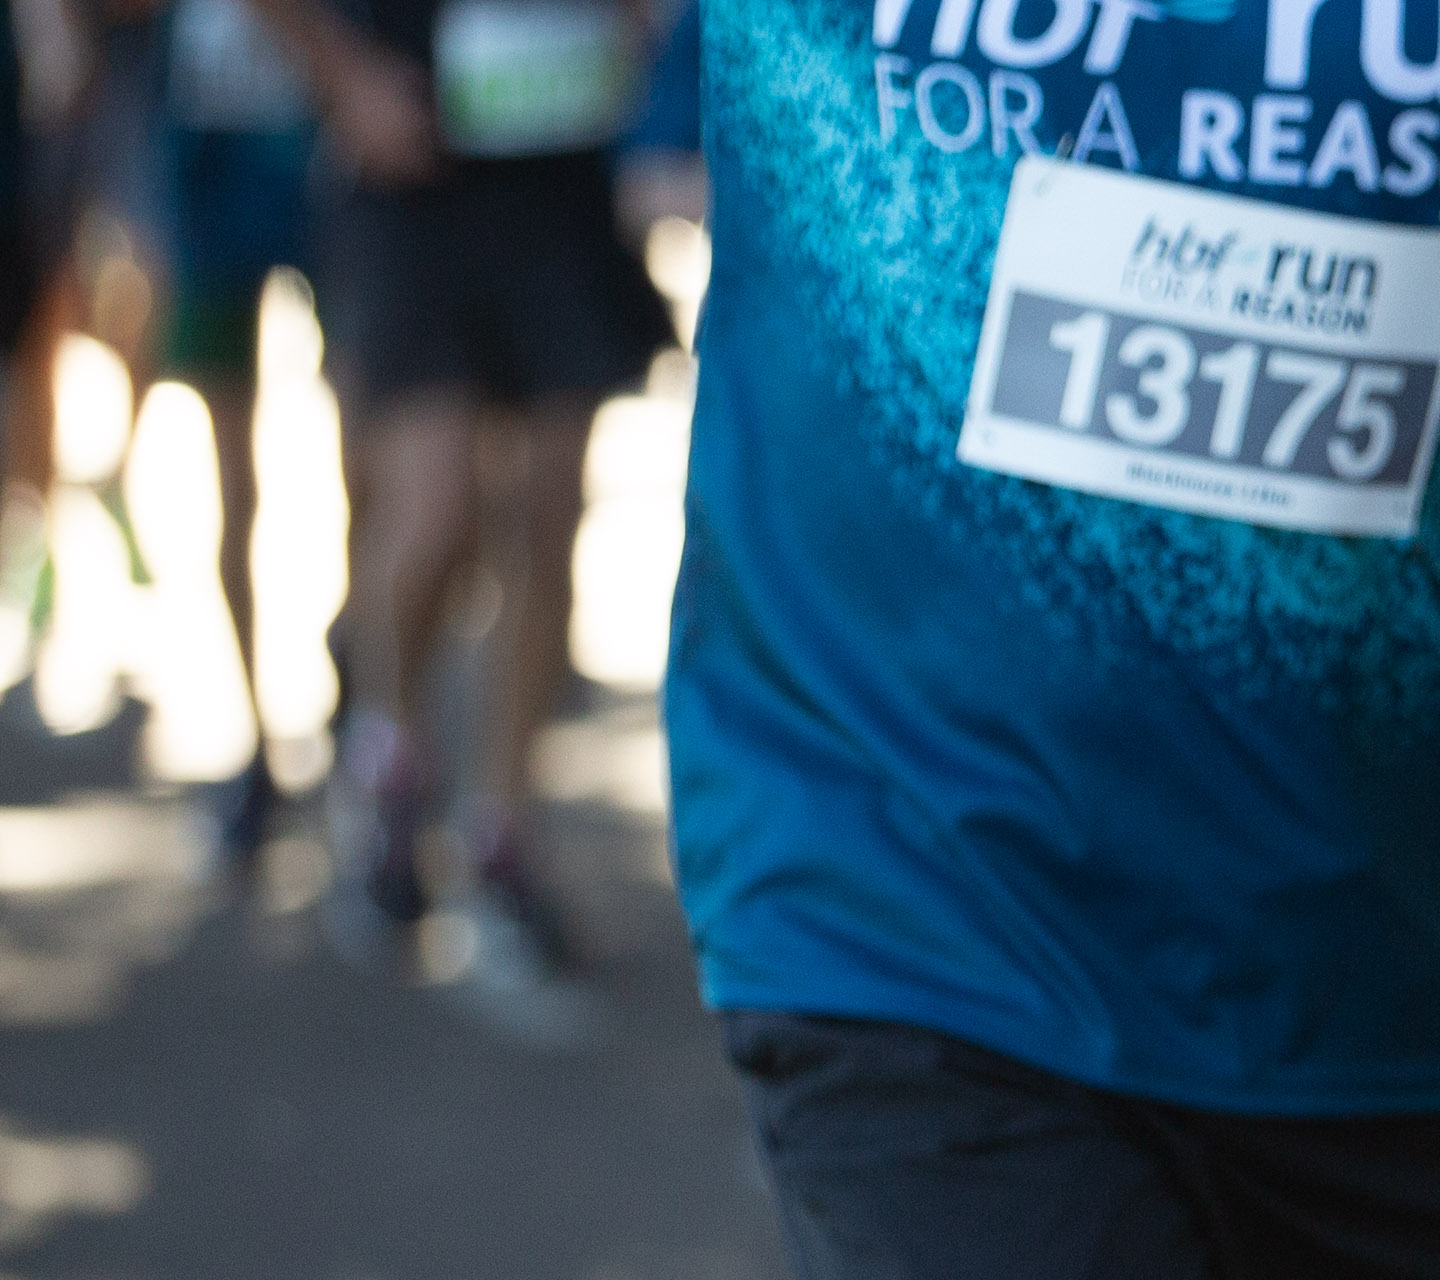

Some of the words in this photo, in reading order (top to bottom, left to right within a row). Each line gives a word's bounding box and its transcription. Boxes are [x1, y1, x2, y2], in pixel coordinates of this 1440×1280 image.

[873, 52, 1045, 158] FOR
[1073, 81, 1142, 170] A
[1132, 214, 1241, 274] hbf
[1268, 241, 1378, 299] run
[1229, 285, 1368, 332] REASON
[1047, 308, 1406, 487] 13175
